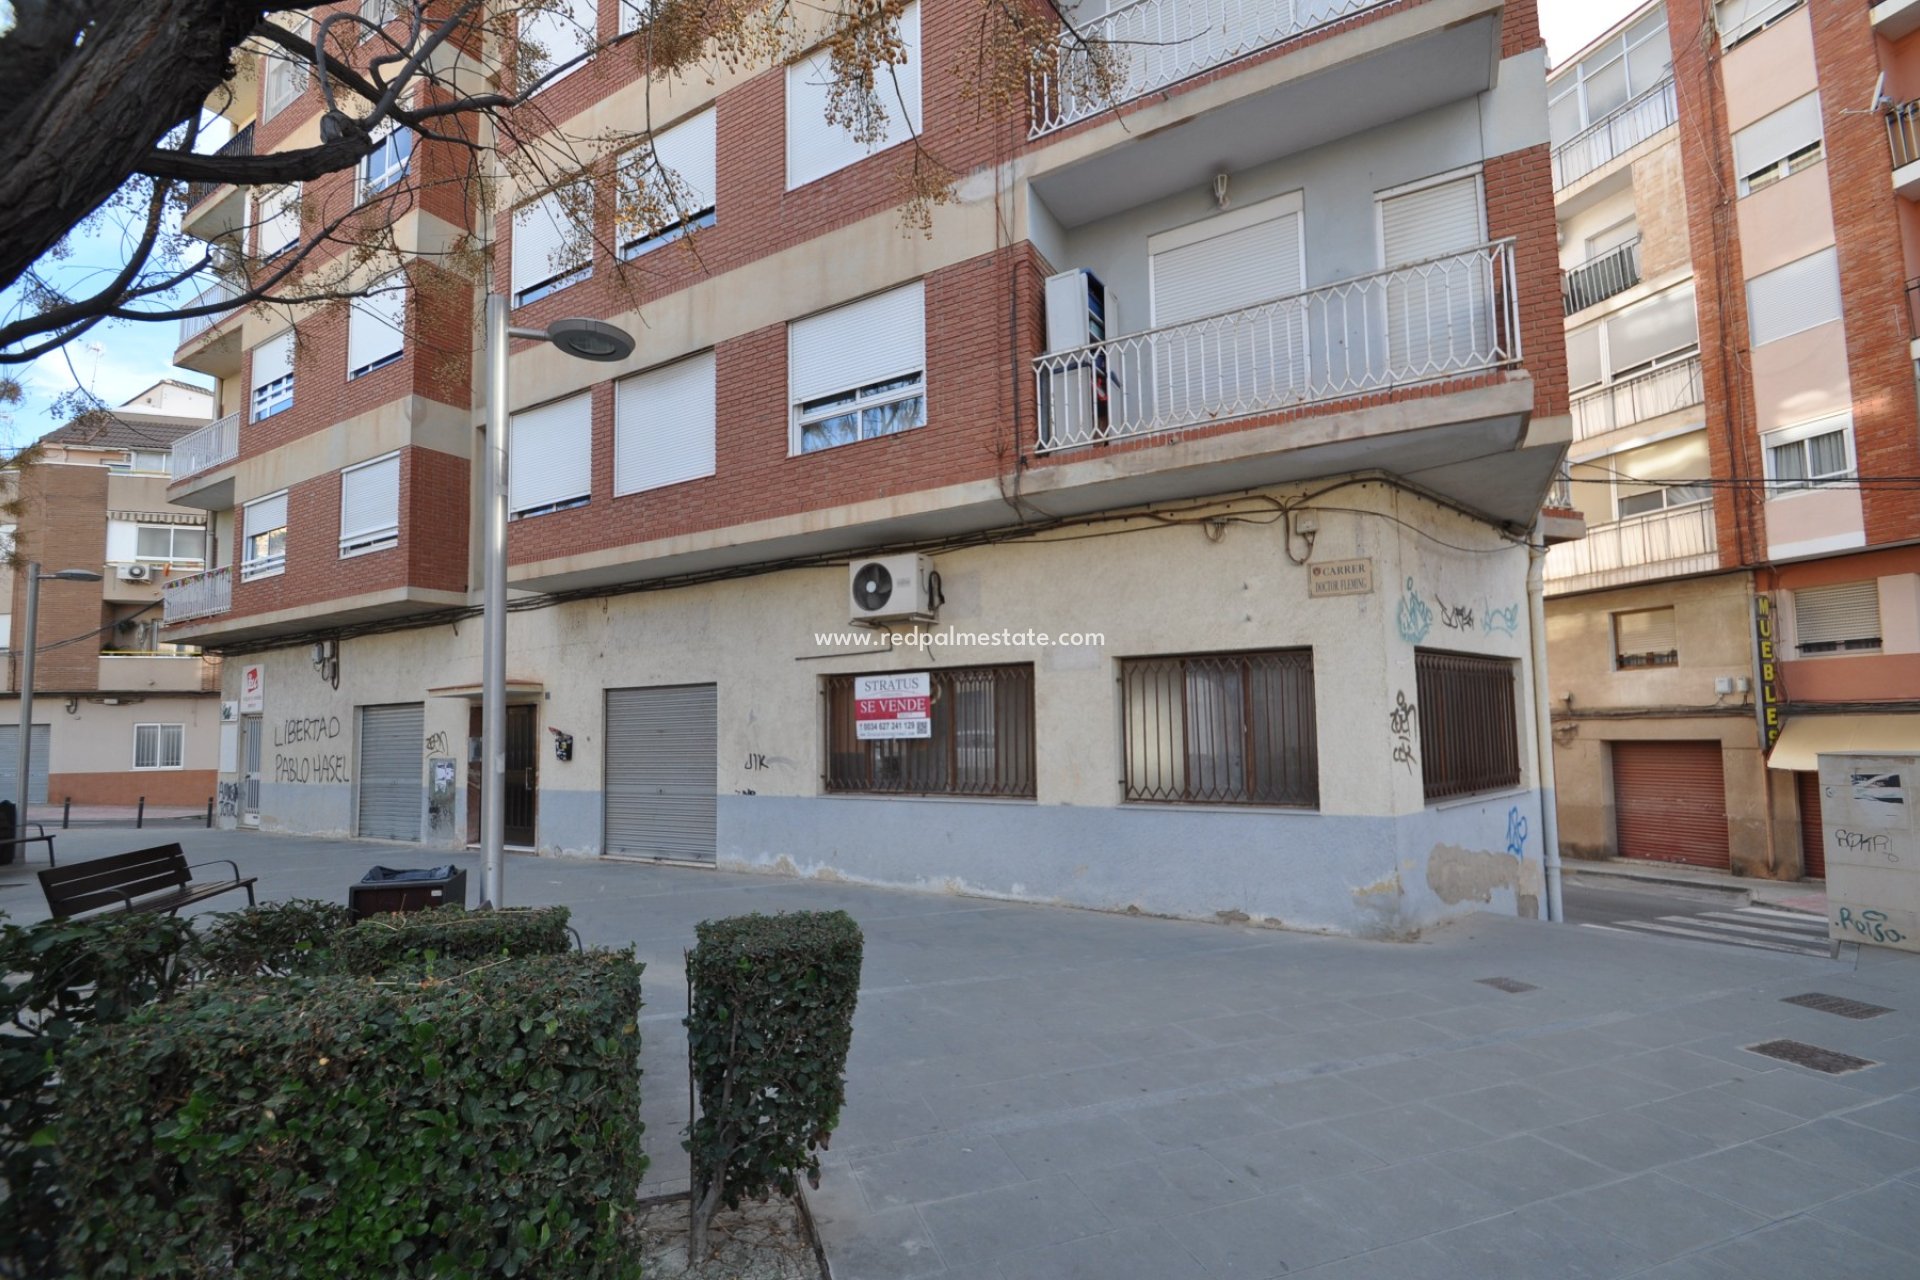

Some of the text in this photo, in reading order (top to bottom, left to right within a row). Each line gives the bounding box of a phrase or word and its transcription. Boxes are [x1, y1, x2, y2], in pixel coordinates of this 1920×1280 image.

[1322, 563, 1366, 577] CARRER
[1758, 597, 1778, 746] MUEBLES
[864, 677, 919, 692] STRATUS
[860, 698, 926, 714] SE VENDE
[274, 716, 340, 747] LIBERTAD
[276, 754, 350, 783] PABLO HASEL
